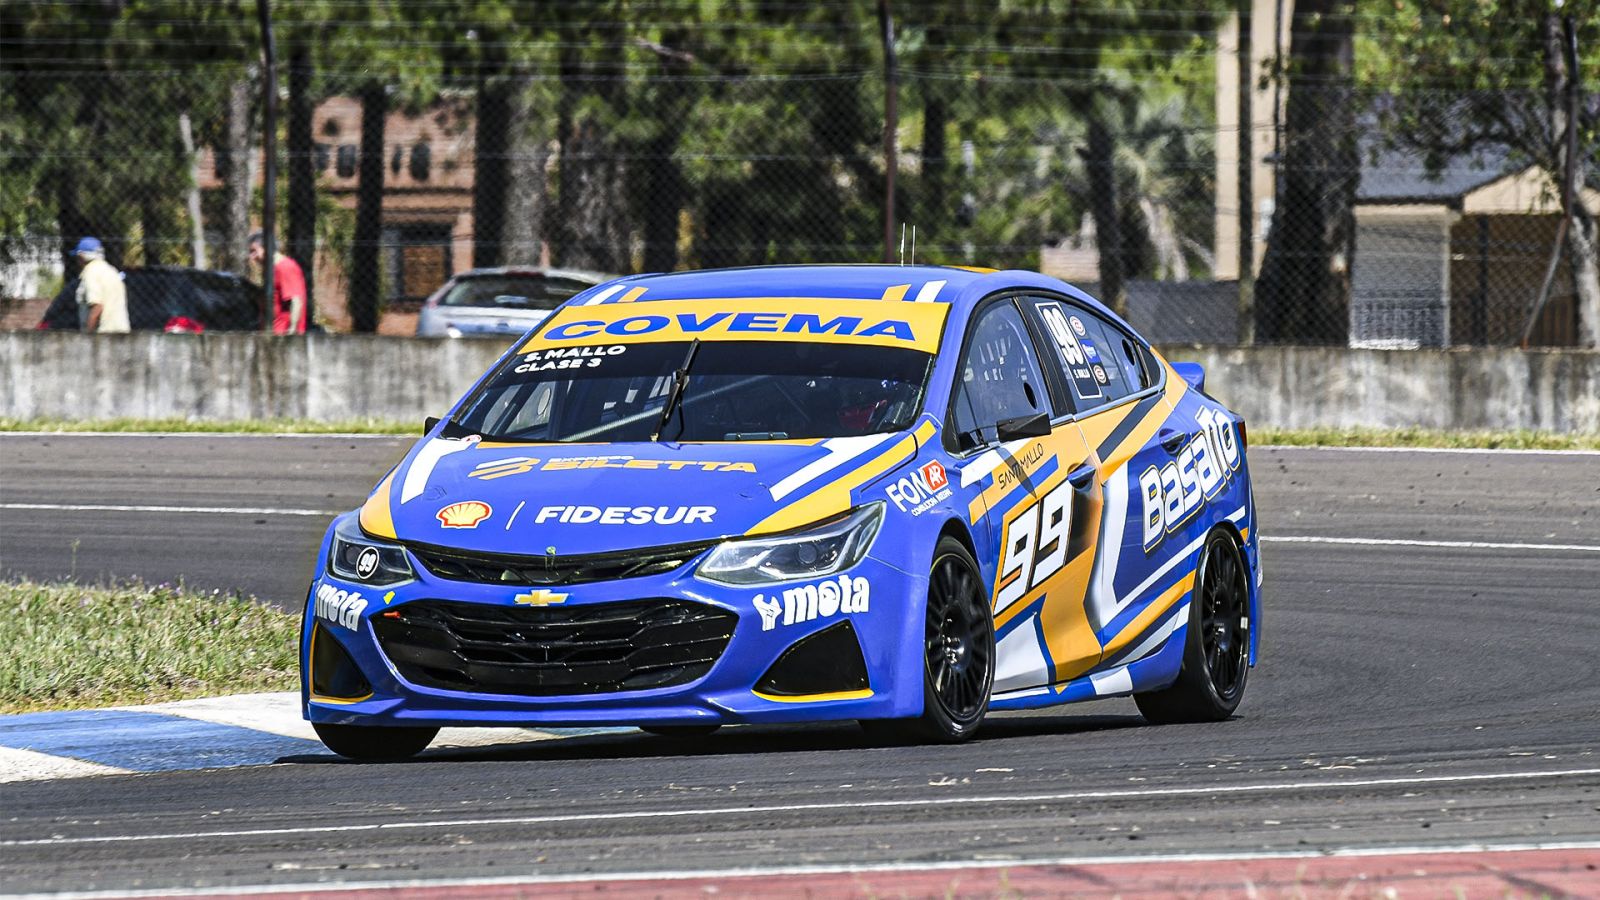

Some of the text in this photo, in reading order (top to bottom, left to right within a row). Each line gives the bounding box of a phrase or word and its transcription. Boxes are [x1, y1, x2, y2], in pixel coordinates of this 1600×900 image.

[543, 312, 916, 342] COVEMA
[1042, 307, 1084, 365] 99
[514, 357, 602, 374] CLASE 3
[524, 345, 627, 363] S. MALLO
[540, 459, 757, 473] BILETTA
[534, 505, 718, 525] FIDESUR
[993, 480, 1074, 618] 99
[358, 552, 377, 573] 99
[316, 583, 369, 632] mota
[782, 574, 870, 626] mota
